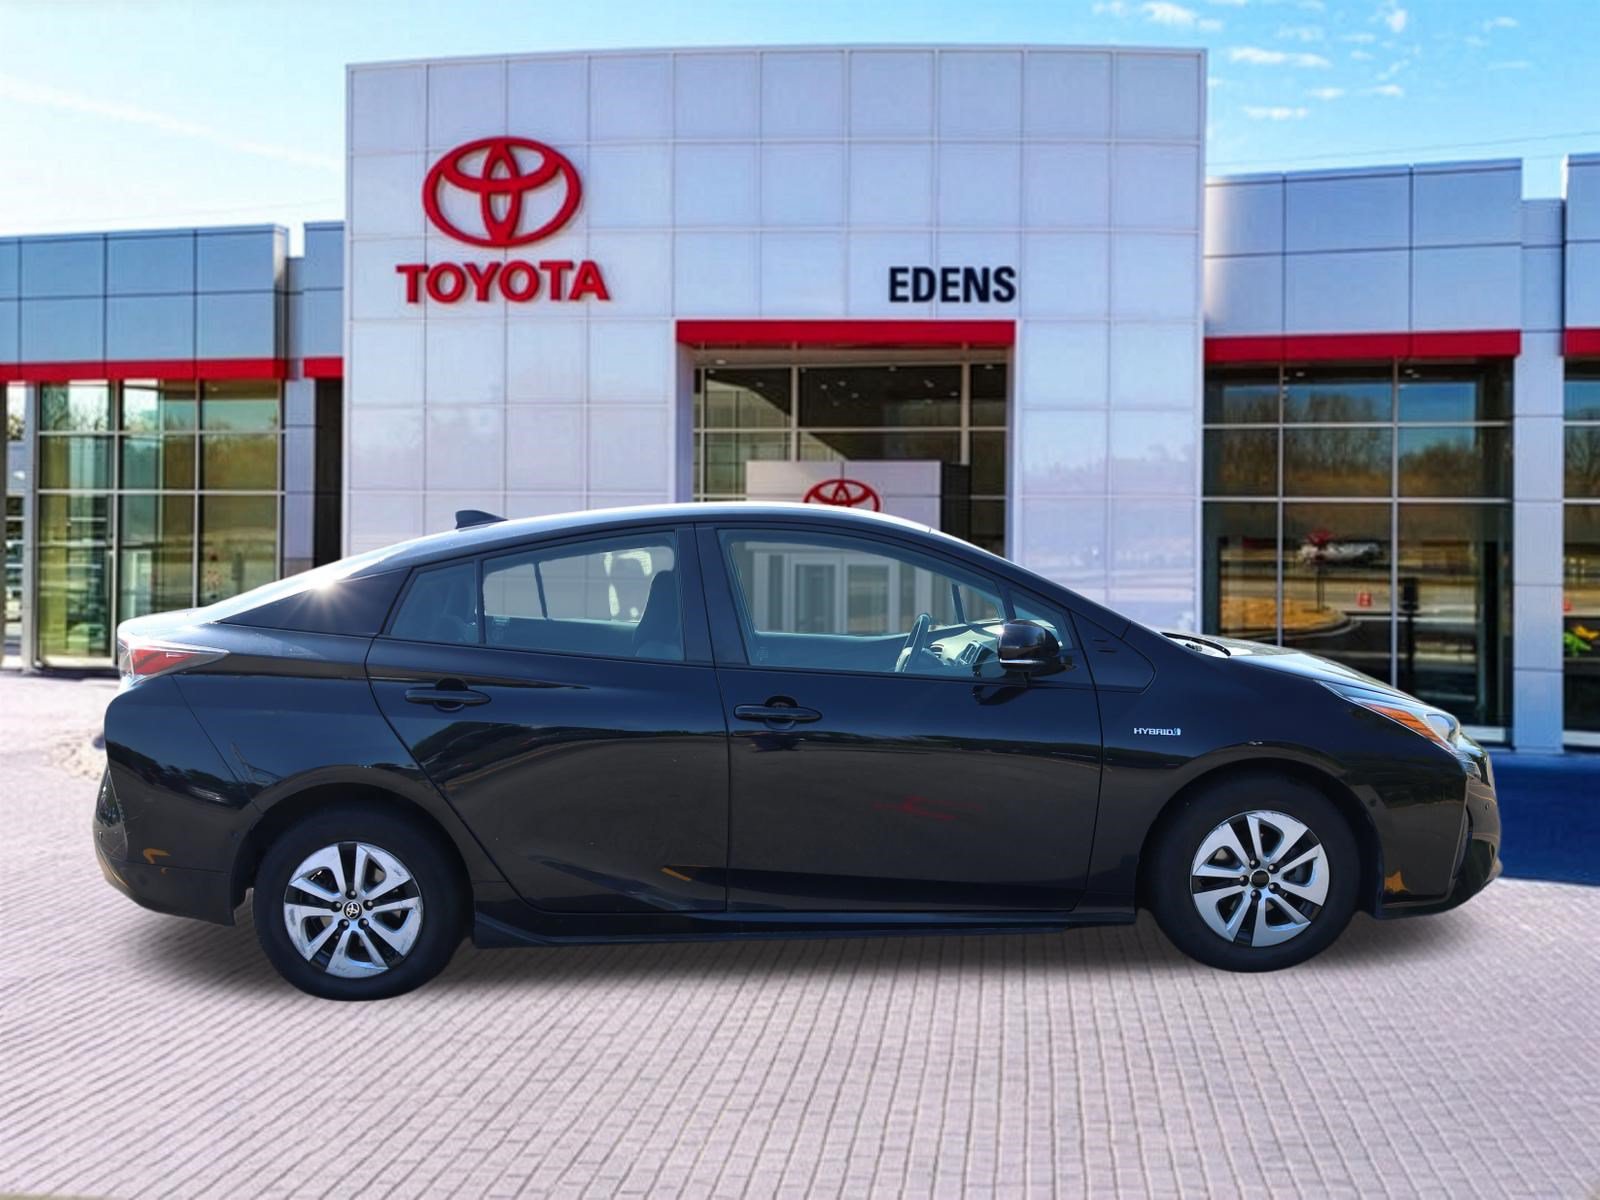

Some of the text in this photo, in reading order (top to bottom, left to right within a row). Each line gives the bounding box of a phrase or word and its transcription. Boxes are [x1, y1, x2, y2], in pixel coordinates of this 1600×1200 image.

[396, 259, 610, 304] TOYOTA
[889, 266, 1017, 303] EDENS
[1133, 727, 1174, 736] HYBRID
